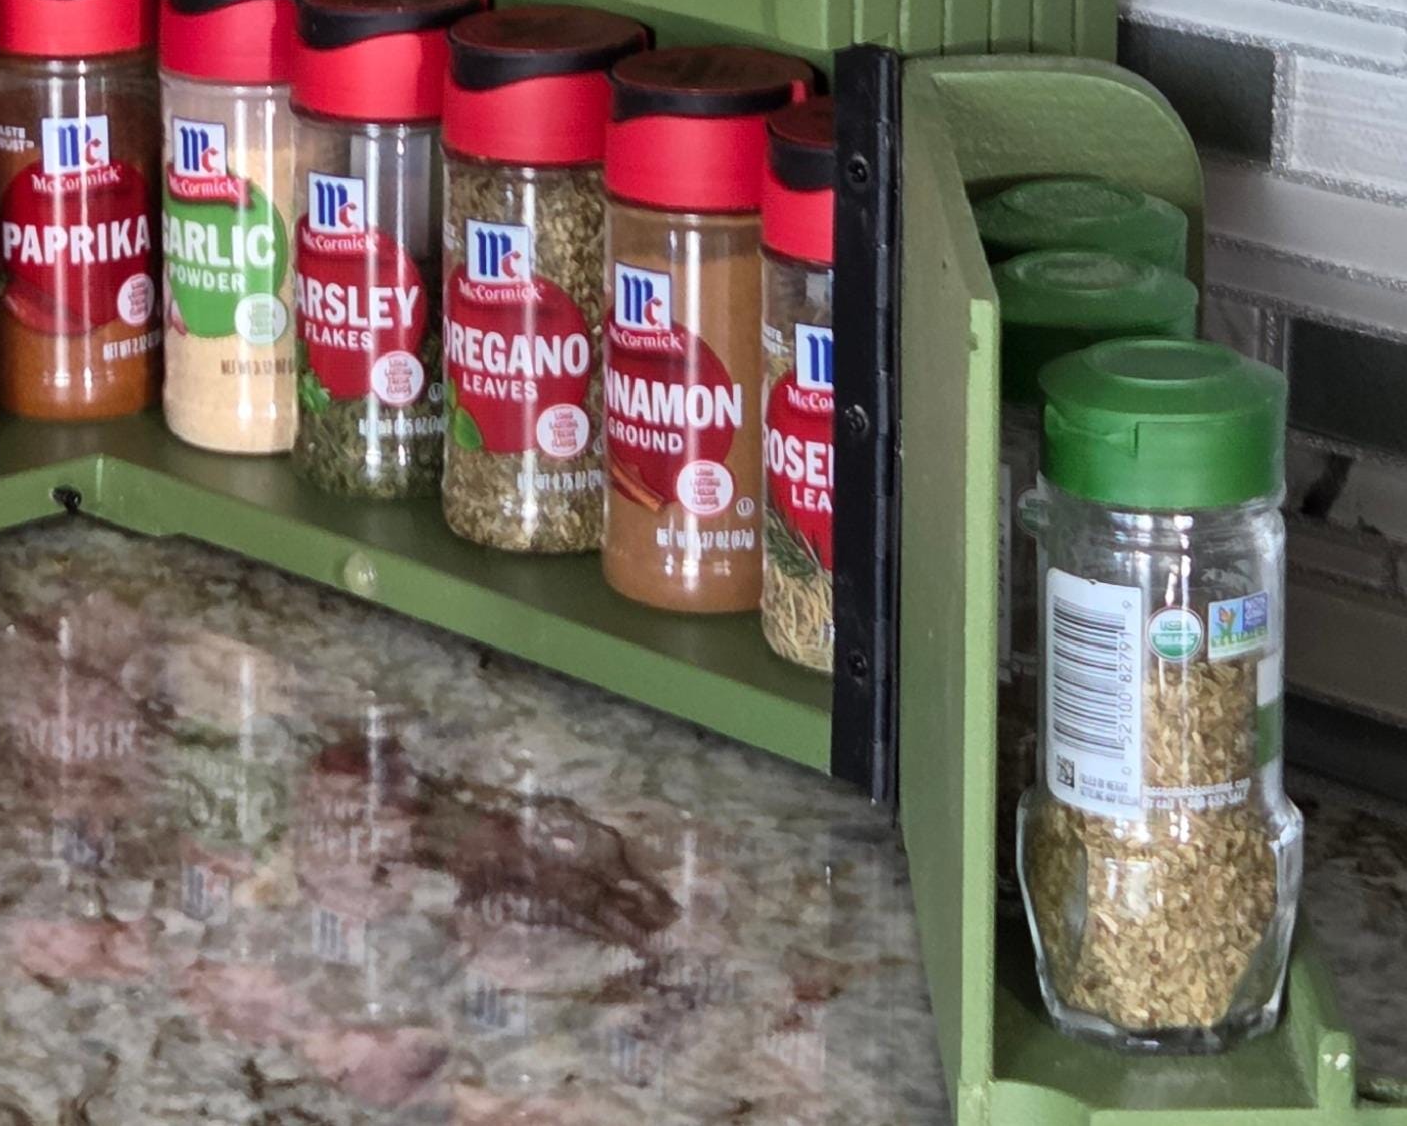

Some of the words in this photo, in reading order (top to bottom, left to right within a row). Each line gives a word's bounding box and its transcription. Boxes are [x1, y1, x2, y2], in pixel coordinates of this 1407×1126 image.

[31, 165, 120, 192] McCormick
[1, 214, 151, 265] PAPRIKA
[304, 320, 374, 352] FLAKES
[462, 371, 539, 402] LEAVES
[608, 416, 684, 454] GROUND
[1118, 631, 1134, 684] 82791
[1118, 691, 1134, 744] 52100
